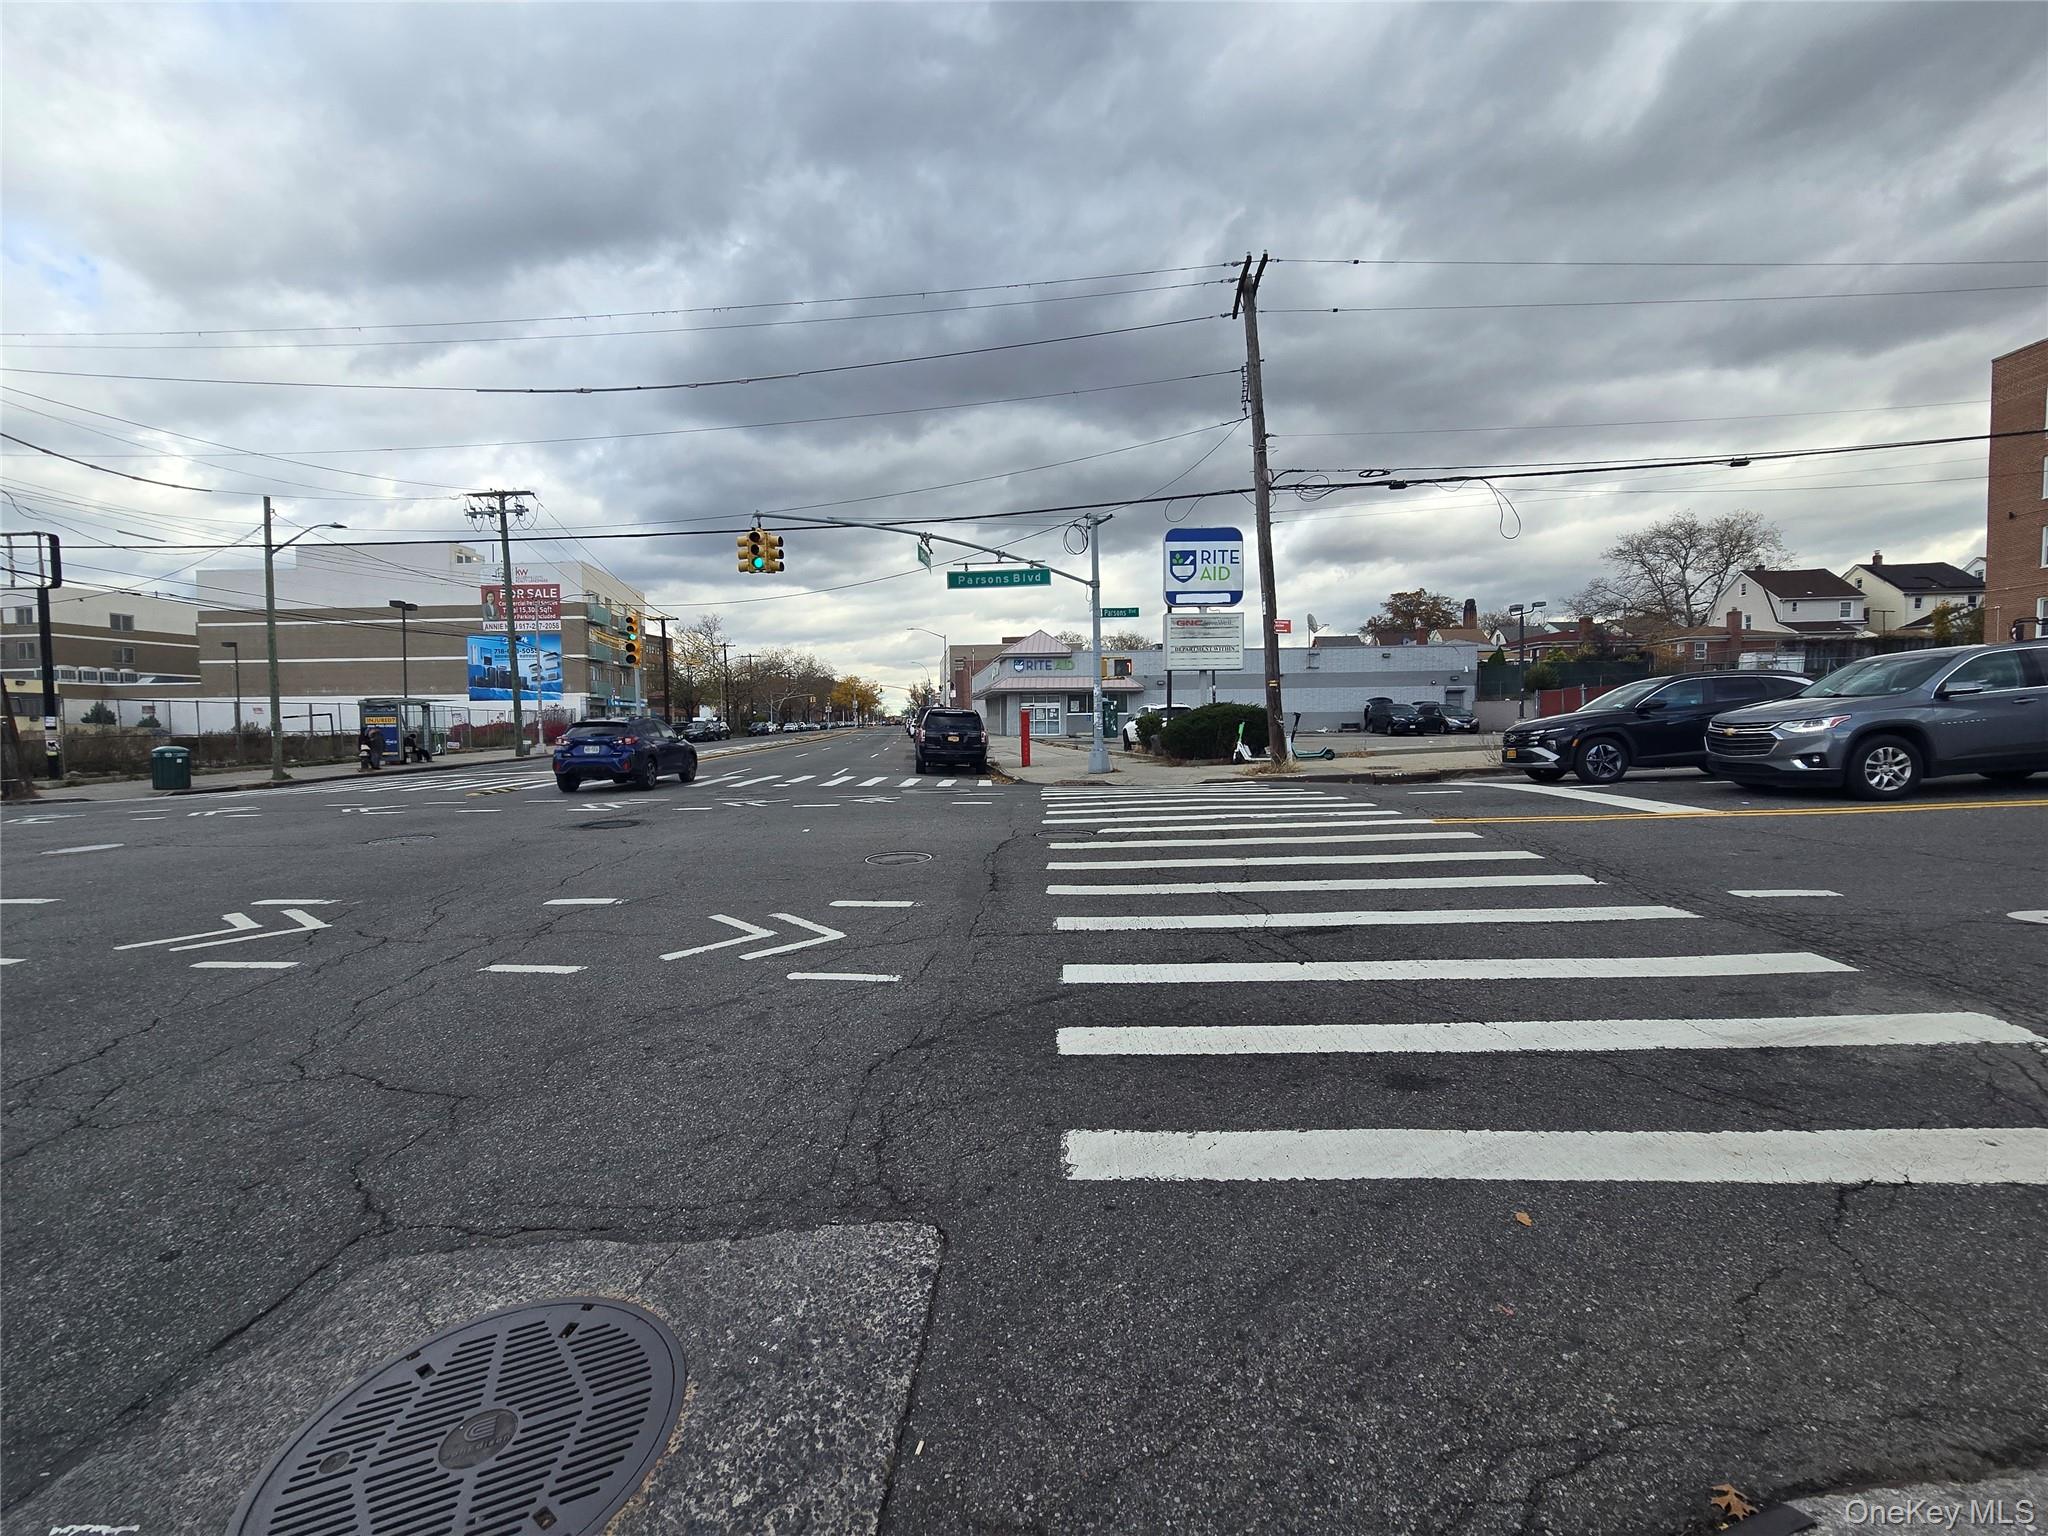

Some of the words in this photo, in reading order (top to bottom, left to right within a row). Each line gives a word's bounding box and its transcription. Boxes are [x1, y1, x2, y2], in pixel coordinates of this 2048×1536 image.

[1201, 550, 1240, 564] RITE
[958, 575, 1009, 585] Parsons
[1013, 573, 1041, 583] Blvd
[1200, 566, 1231, 581] AID
[527, 588, 557, 598] SALE
[1104, 609, 1127, 617] Parsons
[1026, 660, 1053, 670] RITE
